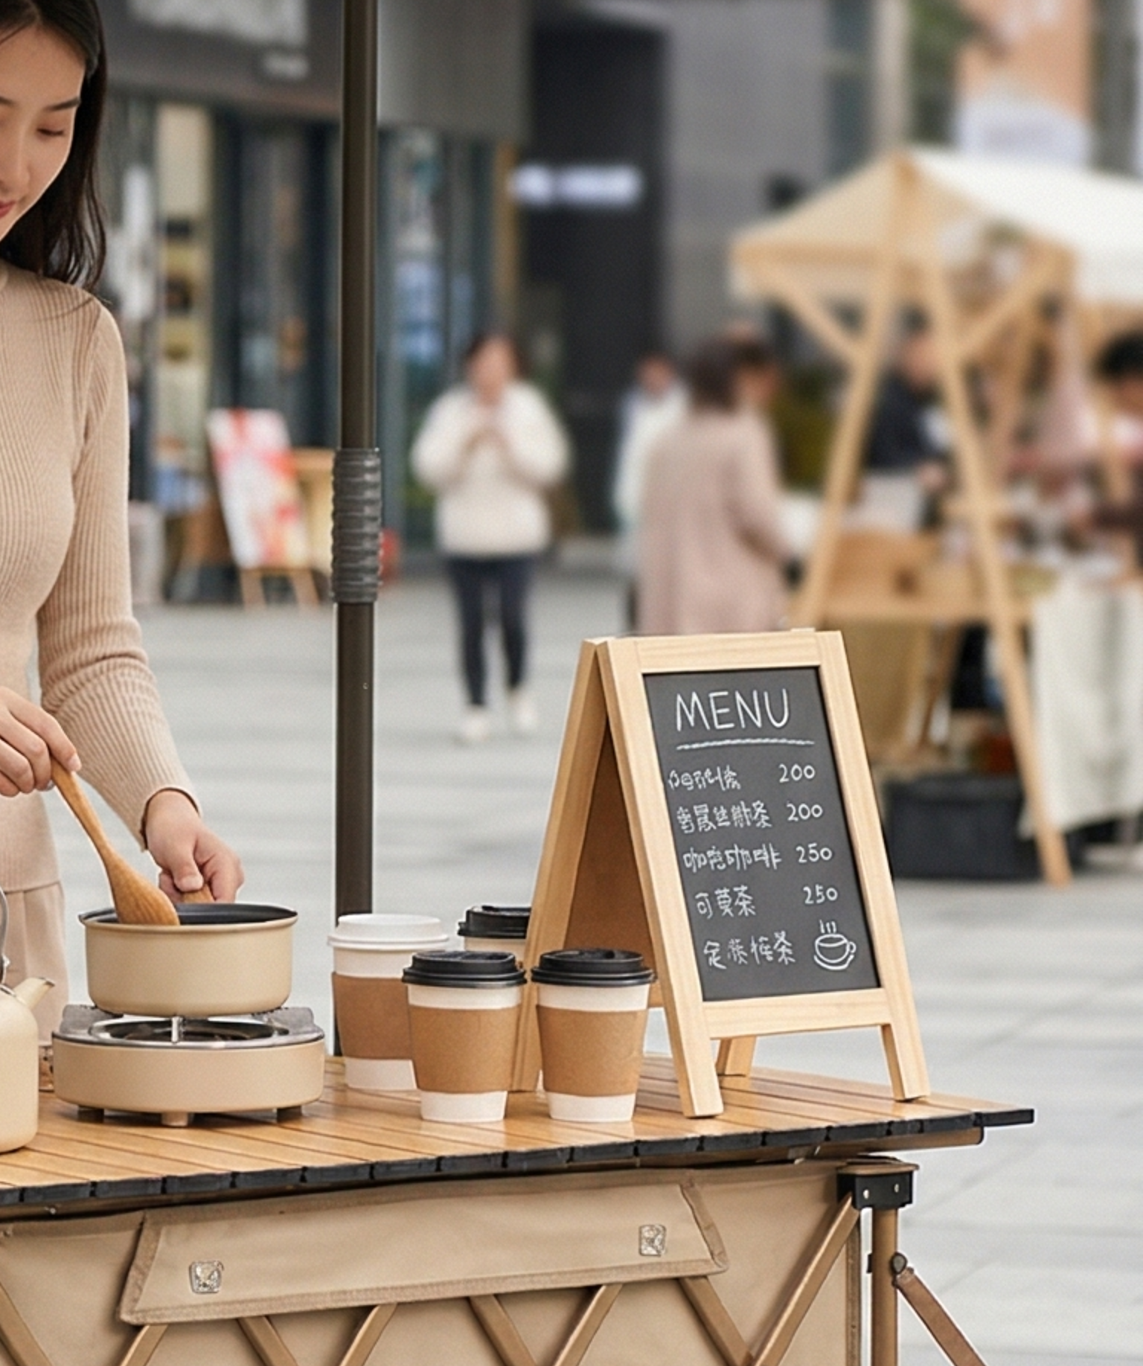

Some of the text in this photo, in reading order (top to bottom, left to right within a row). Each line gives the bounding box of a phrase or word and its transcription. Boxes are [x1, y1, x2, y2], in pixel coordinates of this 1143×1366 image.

[676, 688, 789, 732] MENU
[778, 763, 816, 783] 200
[786, 802, 823, 822] 200
[795, 842, 833, 864] 250
[803, 884, 838, 904] 250
